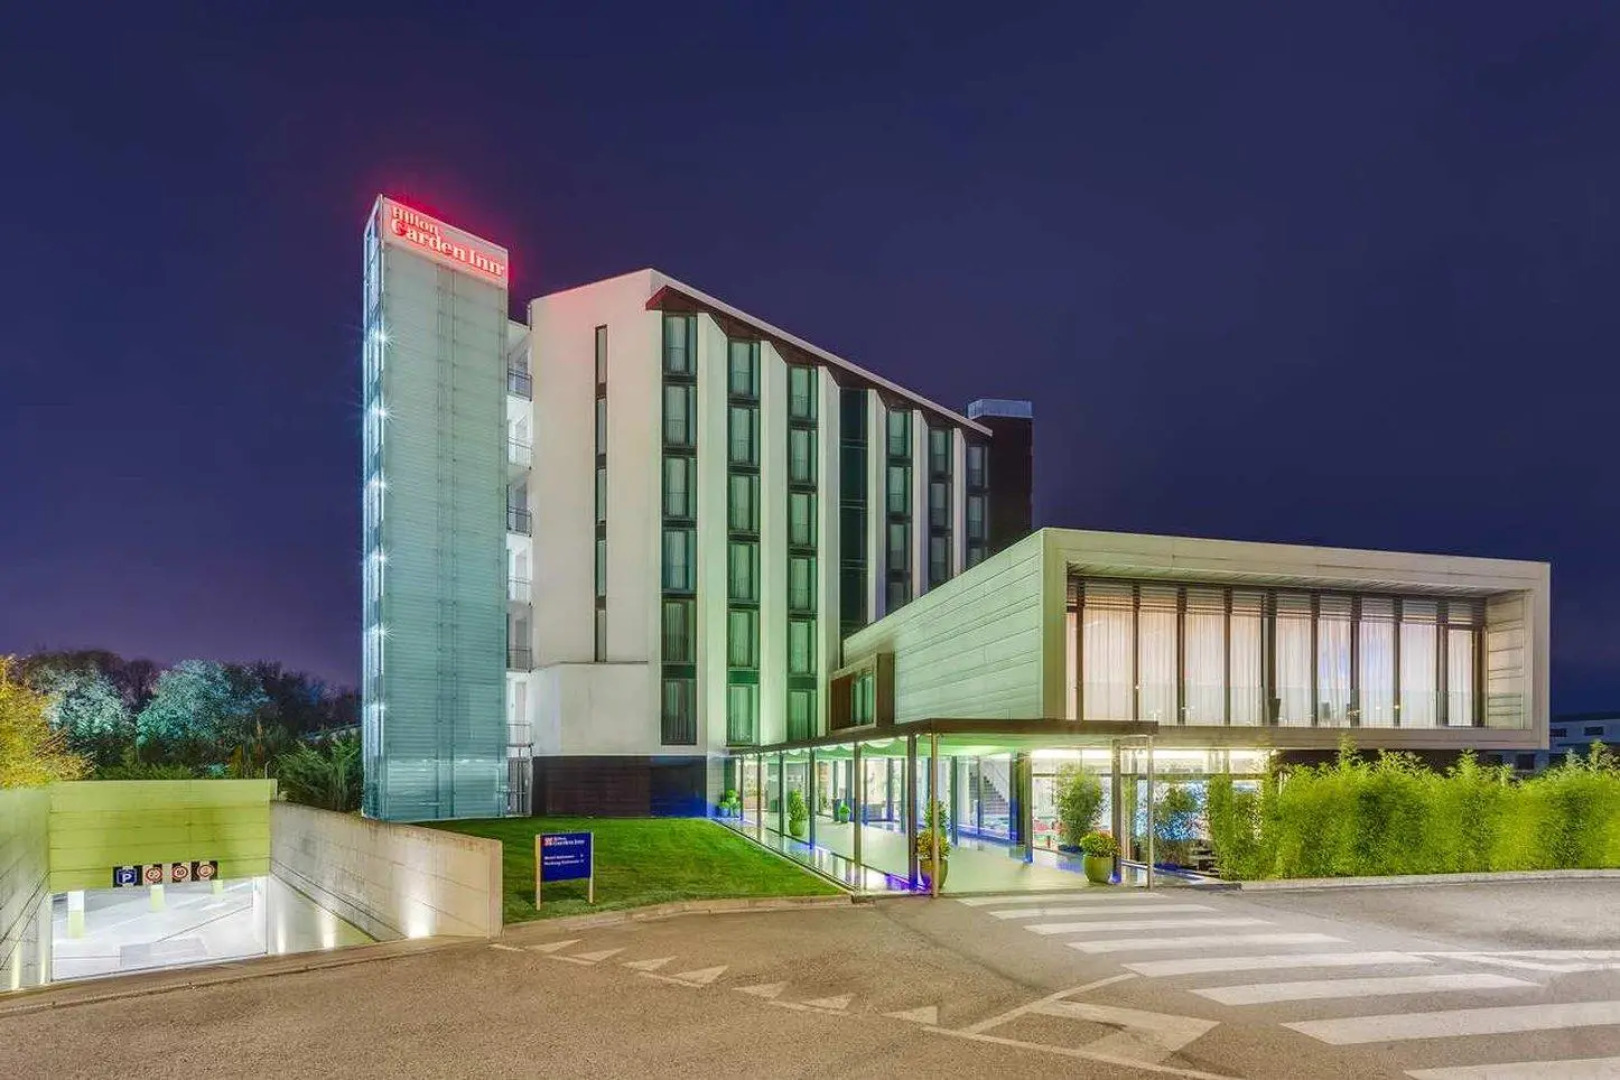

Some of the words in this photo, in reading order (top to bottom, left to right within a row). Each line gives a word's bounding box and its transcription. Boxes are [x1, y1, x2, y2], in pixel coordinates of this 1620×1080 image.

[392, 205, 440, 235] Hilton
[391, 218, 467, 262] Garden
[469, 249, 503, 275] Inn
[122, 873, 132, 883] P
